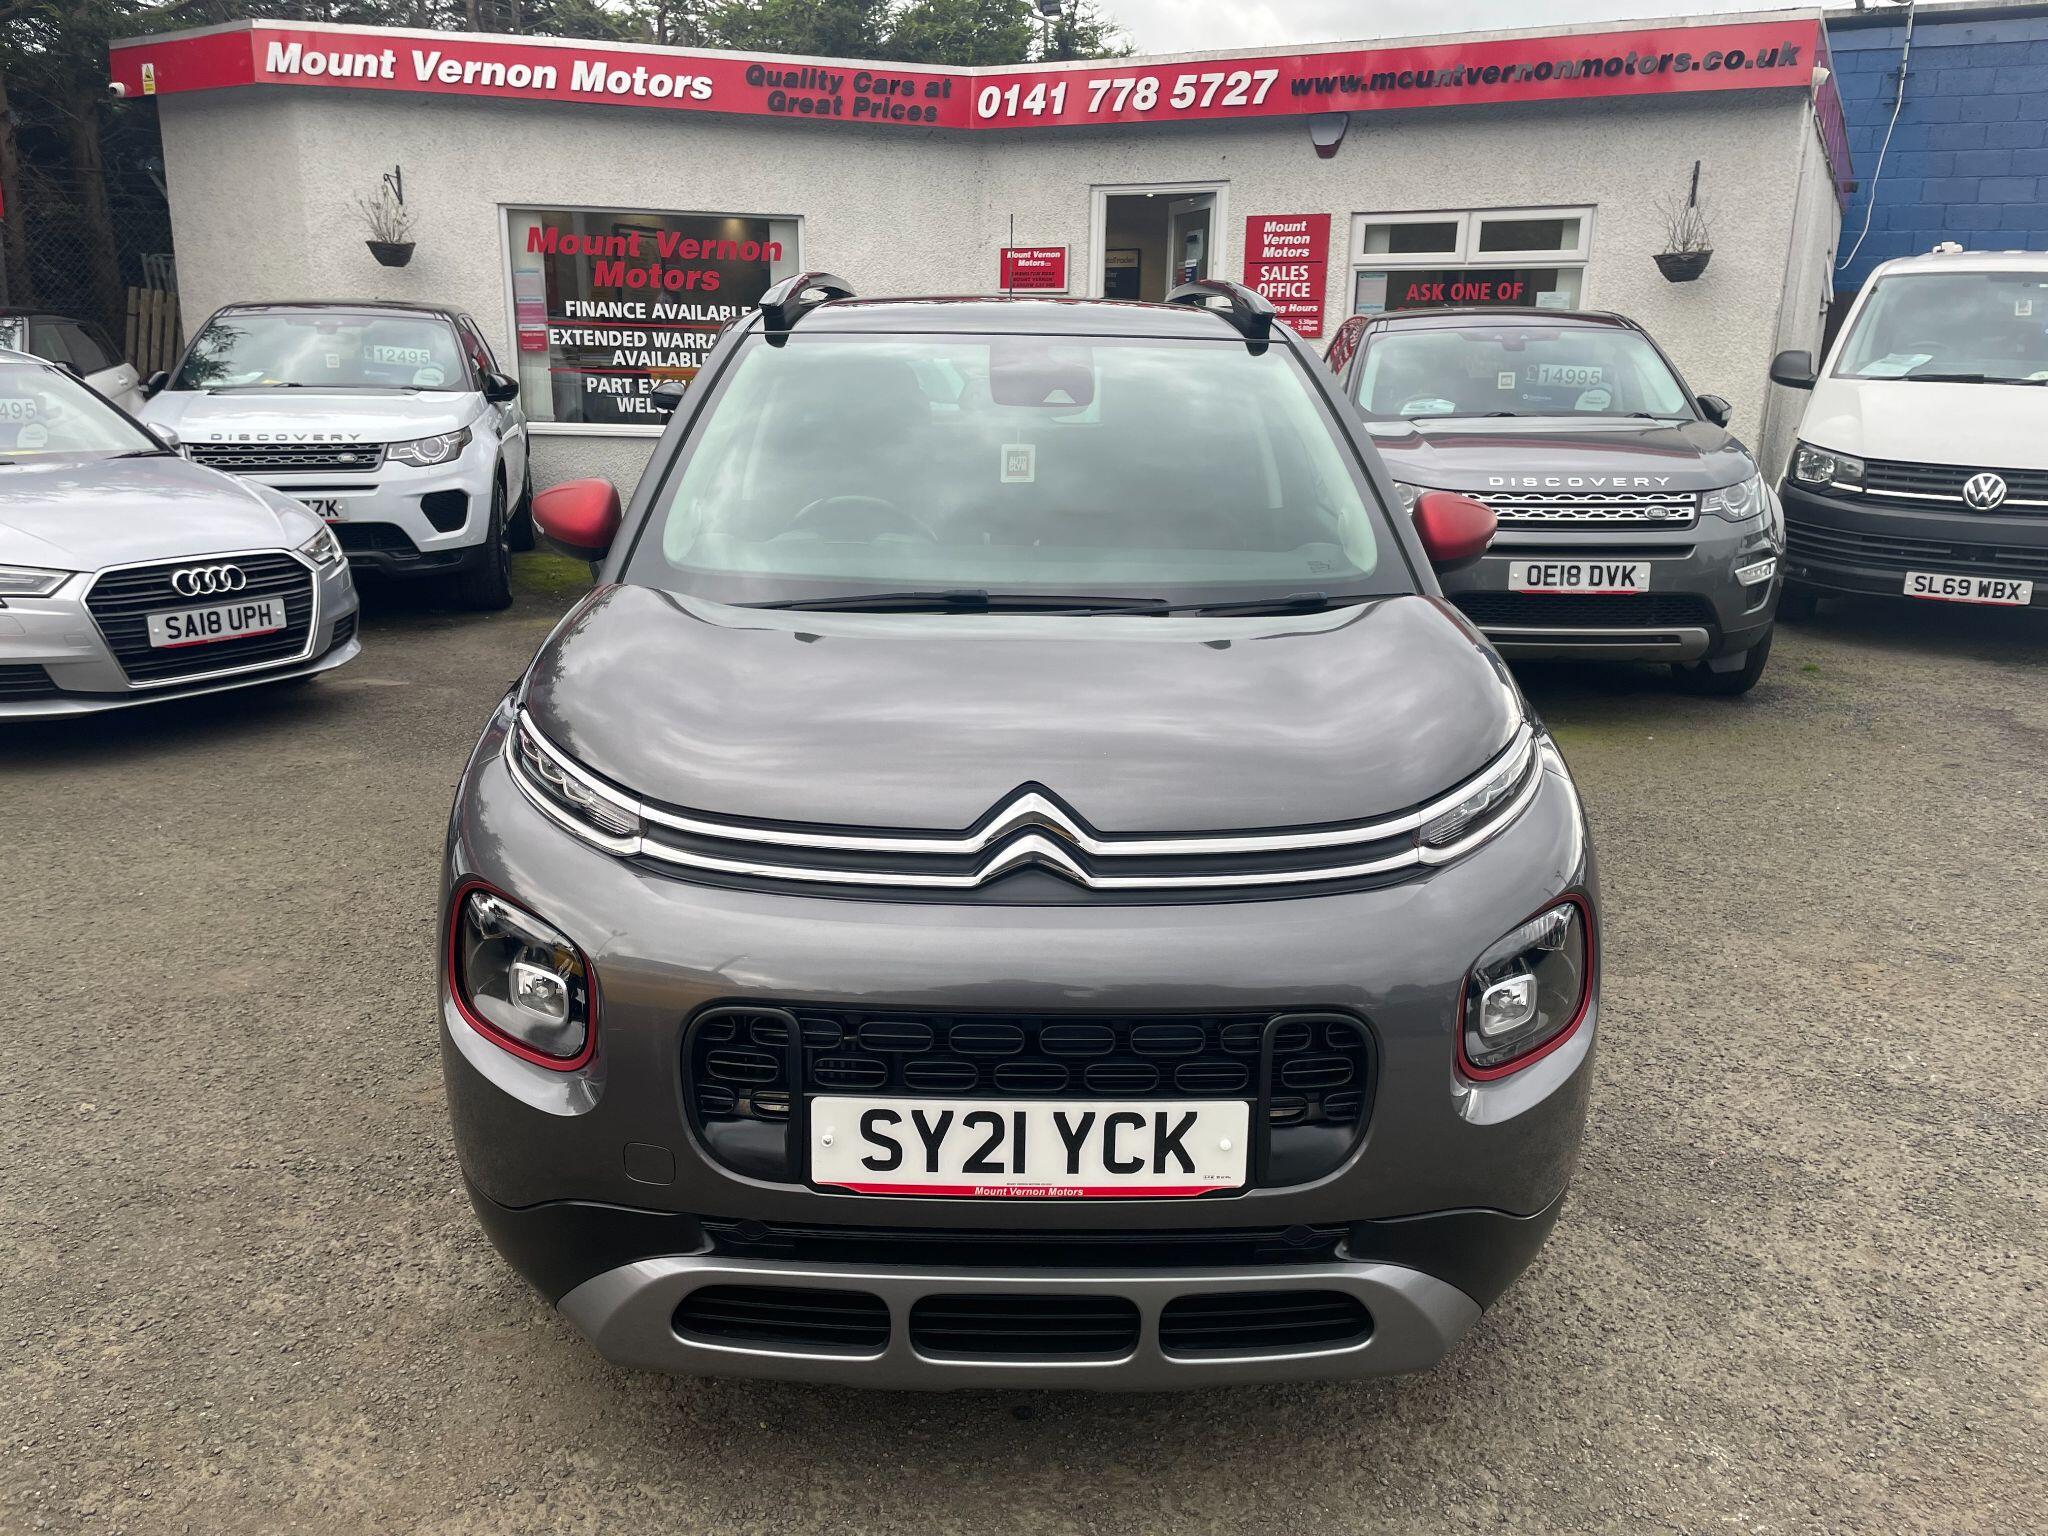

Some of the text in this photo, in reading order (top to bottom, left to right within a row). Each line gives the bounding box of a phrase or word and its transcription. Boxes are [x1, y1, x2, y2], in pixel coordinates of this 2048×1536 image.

[266, 41, 713, 100] Mount Vernon Motors
[1290, 41, 1801, 96] www.mountvernonmotors.co.uk
[745, 64, 951, 98] Quality Cars at
[977, 69, 1279, 119] 0141 778 5727
[767, 90, 938, 122] Great Prices
[1263, 220, 1308, 233] Mount
[527, 226, 783, 261] Mount Vernon
[1263, 234, 1311, 245] Vernon
[1262, 246, 1310, 258] Motors
[594, 260, 720, 291] Motors
[1260, 265, 1309, 281] SALES
[1257, 282, 1311, 298] OFFICE
[1406, 282, 1525, 301] ASK ONE OF
[565, 301, 646, 319] FINANCE
[1289, 303, 1319, 312] Hours
[550, 329, 717, 349] EXTENDED WARRA
[586, 377, 633, 394] PART
[210, 433, 361, 441] DISCOVERY
[1488, 476, 1672, 487] DISCOVERY
[1526, 564, 1637, 588] OE18 DVK
[1914, 575, 2022, 600] SL69 WBX
[165, 603, 273, 640] SA18 UPH
[859, 1108, 1198, 1175] SY21 YCK
[974, 1186, 1084, 1197] Mount Vernon Motors
